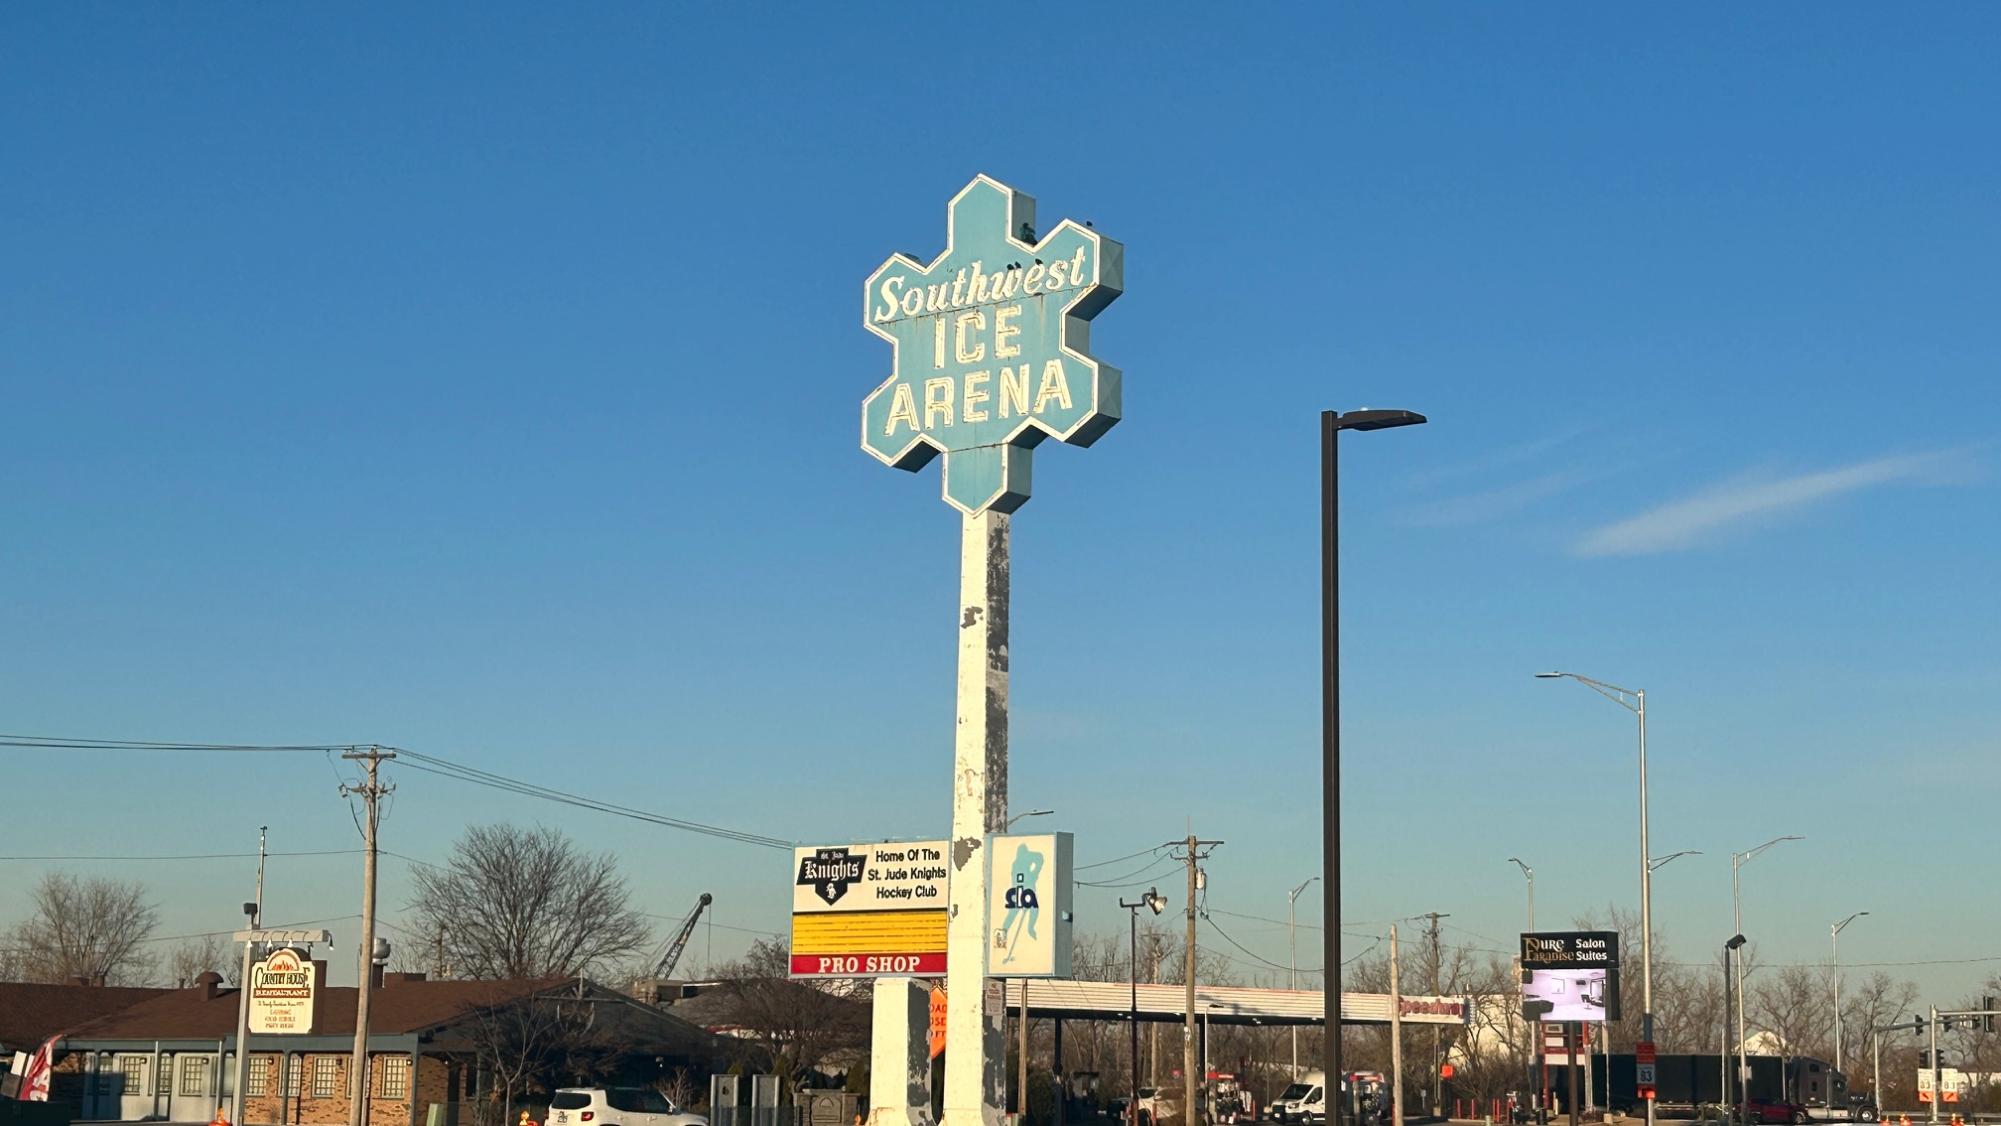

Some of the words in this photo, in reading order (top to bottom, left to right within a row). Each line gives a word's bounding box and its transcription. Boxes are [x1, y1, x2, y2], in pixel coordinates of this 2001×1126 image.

[874, 245, 1086, 322] Southwest
[933, 304, 1022, 369] ICE
[883, 358, 1073, 437] ARENA
[876, 850, 904, 863] Home
[907, 849, 919, 861] Of
[922, 848, 940, 860] The
[804, 859, 860, 882] Knights
[867, 869, 882, 881] St.
[885, 869, 907, 880] Jude
[910, 866, 947, 882] Knights
[876, 886, 912, 900] Hockey
[915, 885, 937, 898] Club
[1575, 938, 1606, 949] Salon
[1576, 950, 1608, 961] Suites
[819, 957, 859, 973] PRO
[866, 956, 921, 972] SHOP
